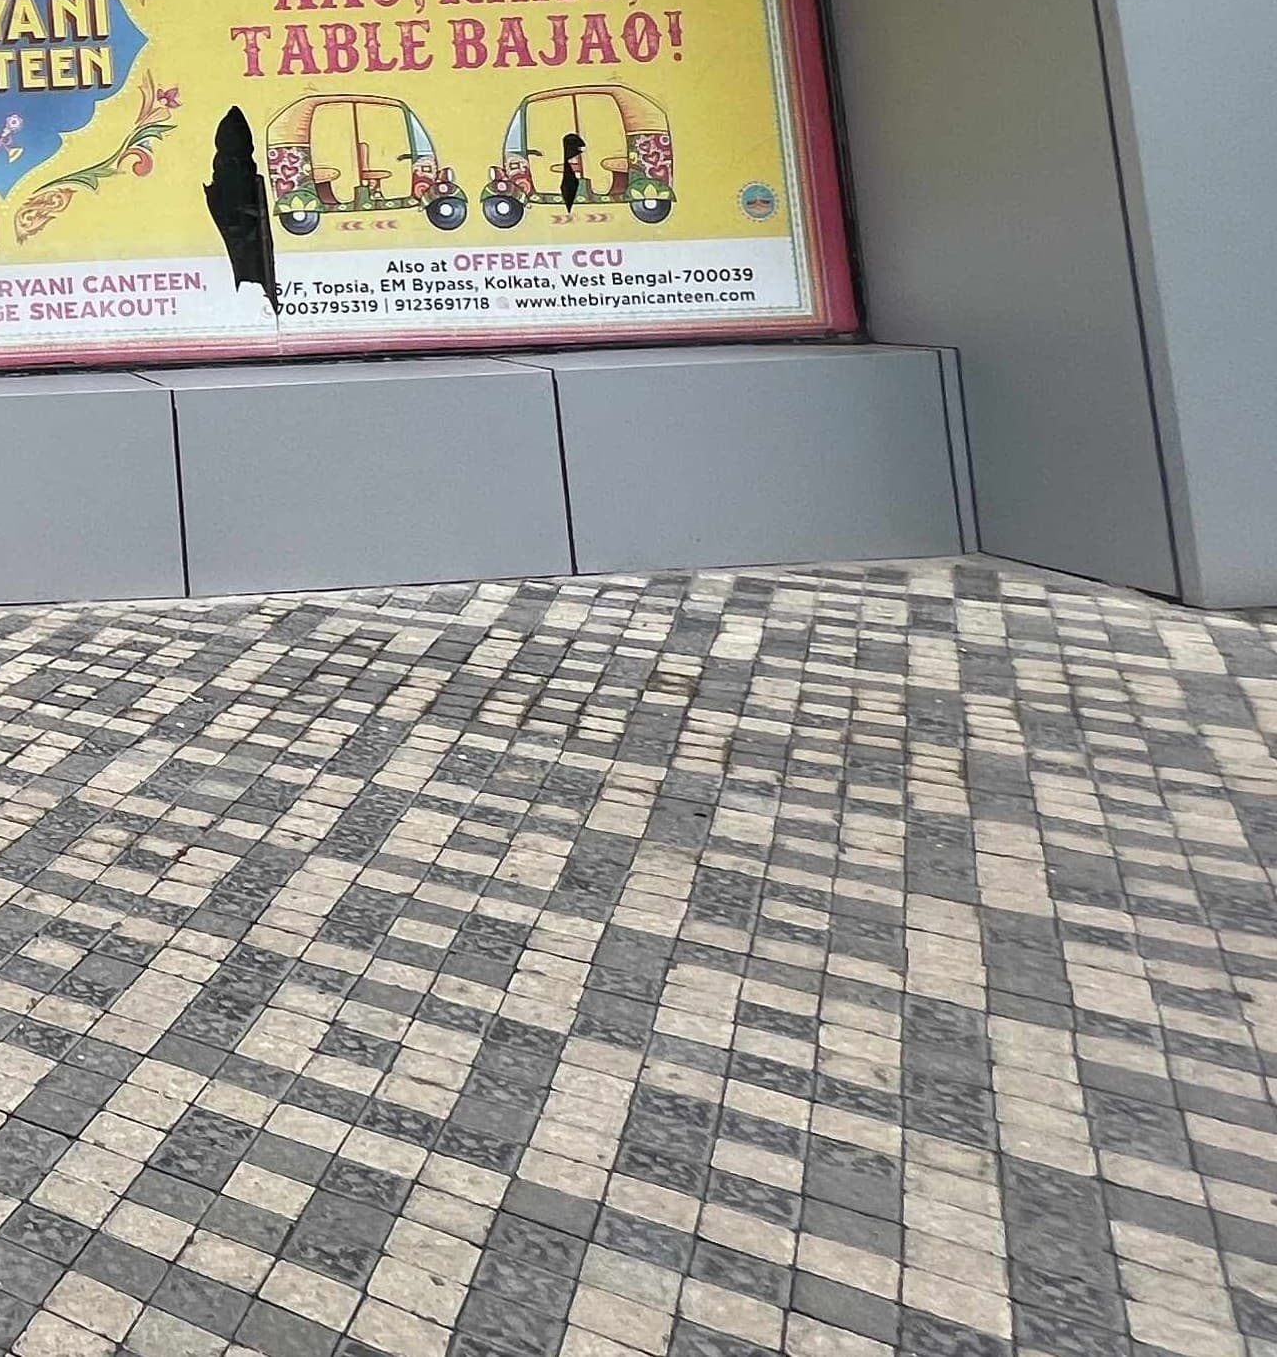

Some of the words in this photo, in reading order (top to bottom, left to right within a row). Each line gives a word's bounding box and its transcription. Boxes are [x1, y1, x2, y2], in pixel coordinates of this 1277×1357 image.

[230, 19, 434, 78] TABLE
[447, 10, 684, 69] BAJAO!
[386, 260, 425, 274] Also
[430, 259, 448, 273] at
[453, 251, 562, 272] OFFBEAT
[571, 248, 624, 268] CCU
[82, 272, 208, 295] CANTEEN,
[312, 279, 375, 297] Topsia,
[380, 278, 407, 292] EM
[412, 276, 479, 295] Bypass,
[484, 274, 556, 291] Kolkata,
[560, 271, 605, 287] West
[611, 267, 754, 287] Bengal-700039
[29, 297, 177, 321] SNEAKOUT!
[276, 300, 378, 315] 7003795319
[395, 297, 490, 312] 9123691718
[515, 289, 756, 310] www.thebiryanicanteen.com
